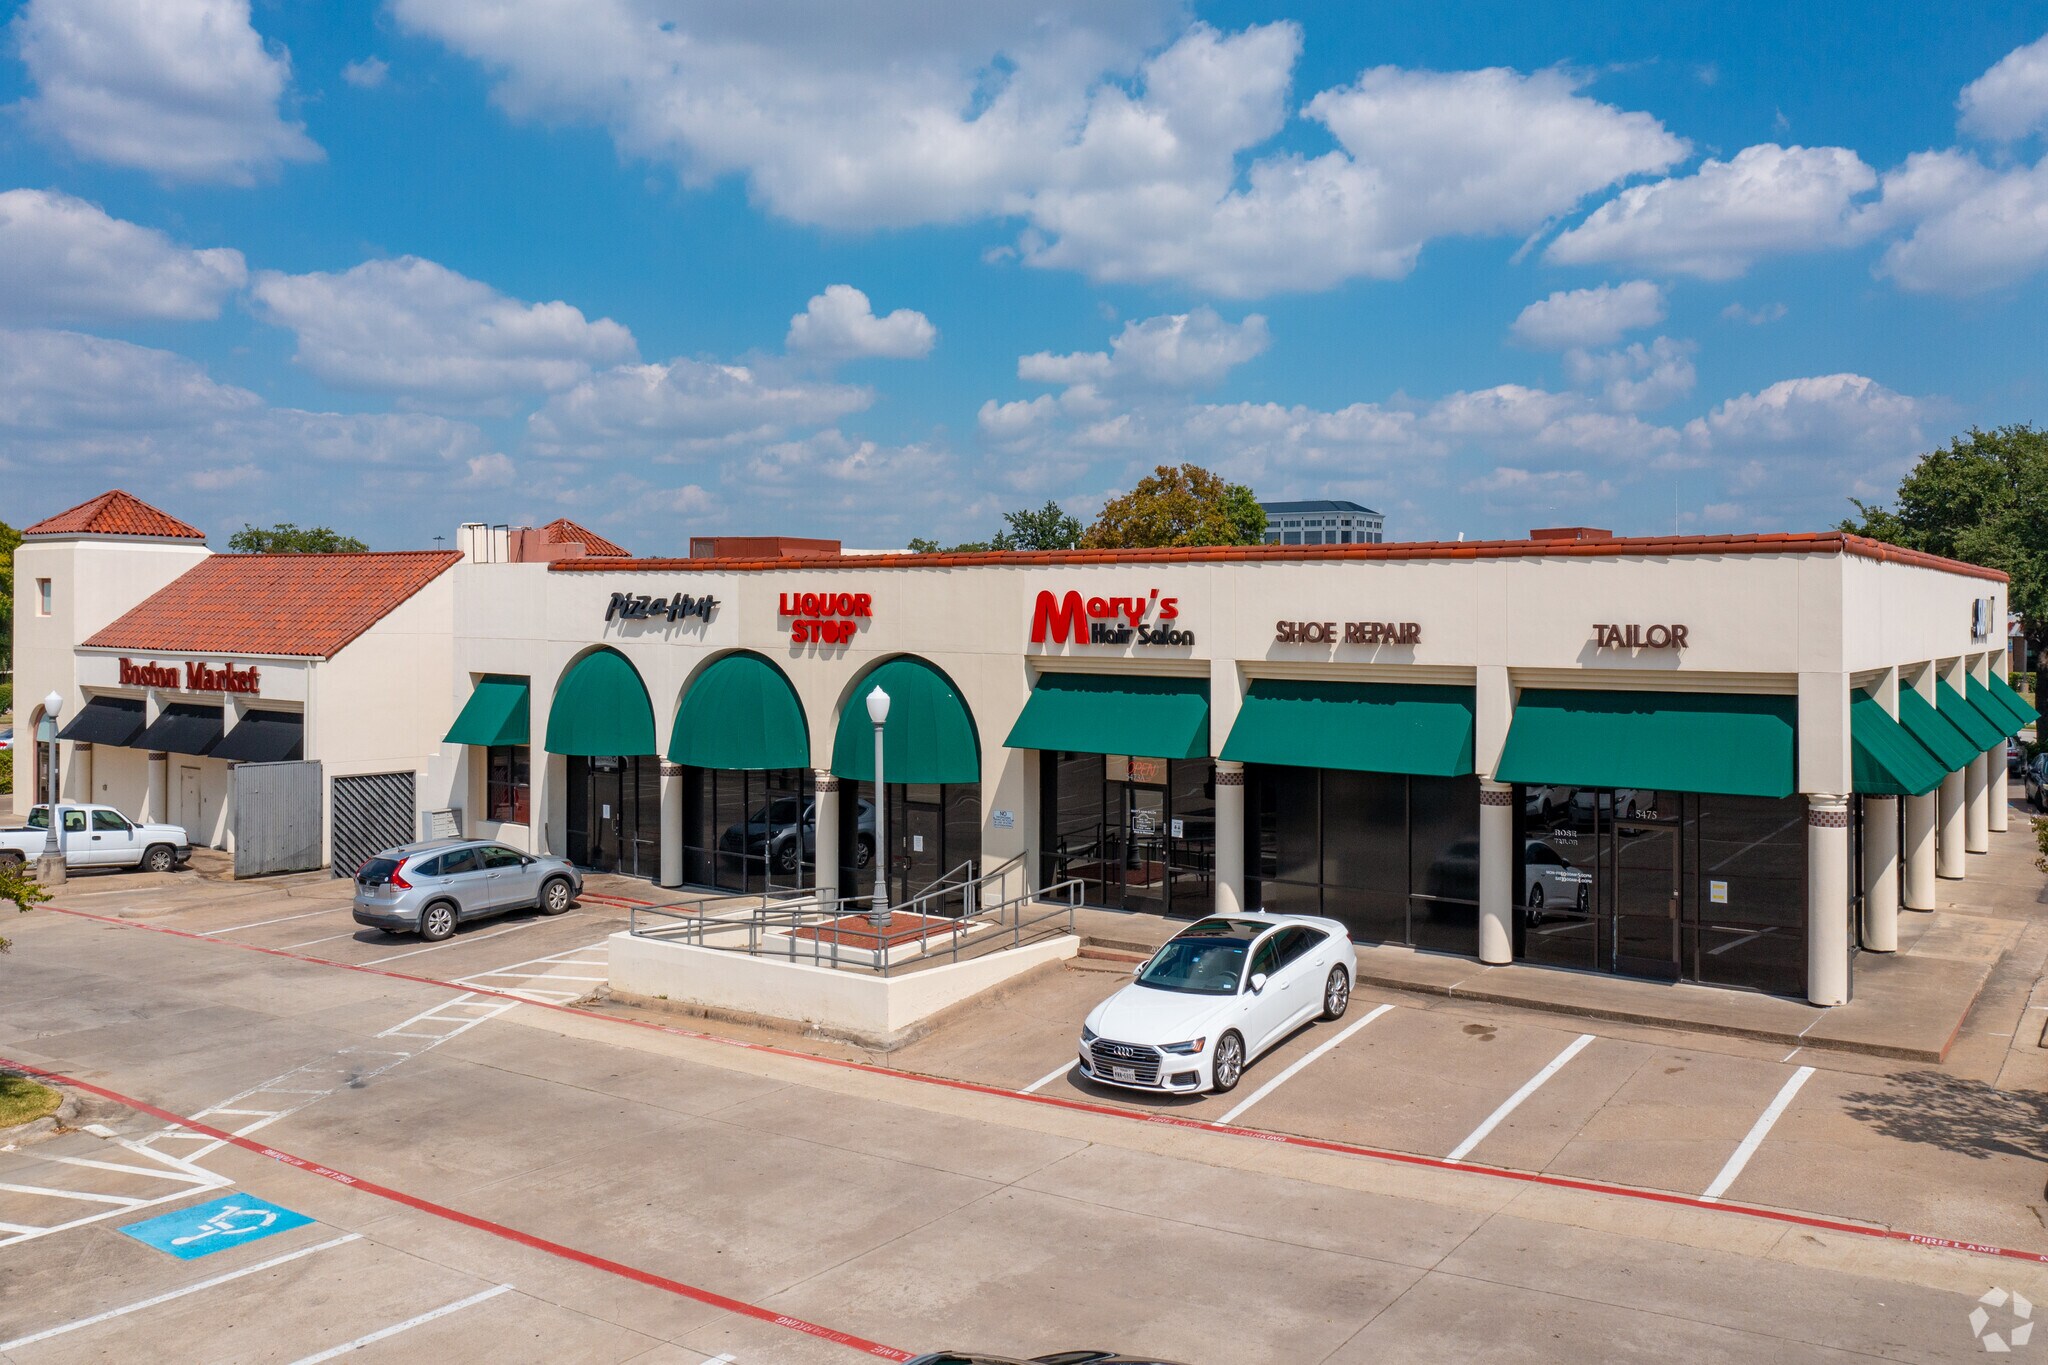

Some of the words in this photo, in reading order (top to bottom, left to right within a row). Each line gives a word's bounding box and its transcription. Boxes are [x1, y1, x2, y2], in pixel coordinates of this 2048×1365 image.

[605, 592, 668, 620] Pizza
[666, 592, 721, 623] Hut
[780, 592, 873, 618] LIQUOR
[1031, 589, 1179, 645] Mary's
[792, 619, 857, 644] STOP
[1091, 623, 1134, 645] Hair
[1138, 623, 1195, 646] Salon
[1276, 620, 1338, 644] SHOE
[1345, 622, 1421, 645] REPAIR
[1592, 624, 1689, 648] TAILOR
[119, 657, 181, 689] Boston
[185, 661, 261, 693] Market
[1127, 761, 1158, 777] OPEN
[1635, 810, 1657, 819] 5475
[1240, 1130, 1287, 1142] PARKING
[1910, 1235, 1950, 1247] FIRE
[1954, 1241, 2001, 1254] LANE
[775, 1316, 831, 1337] PARKING
[870, 1345, 913, 1361] LANE
